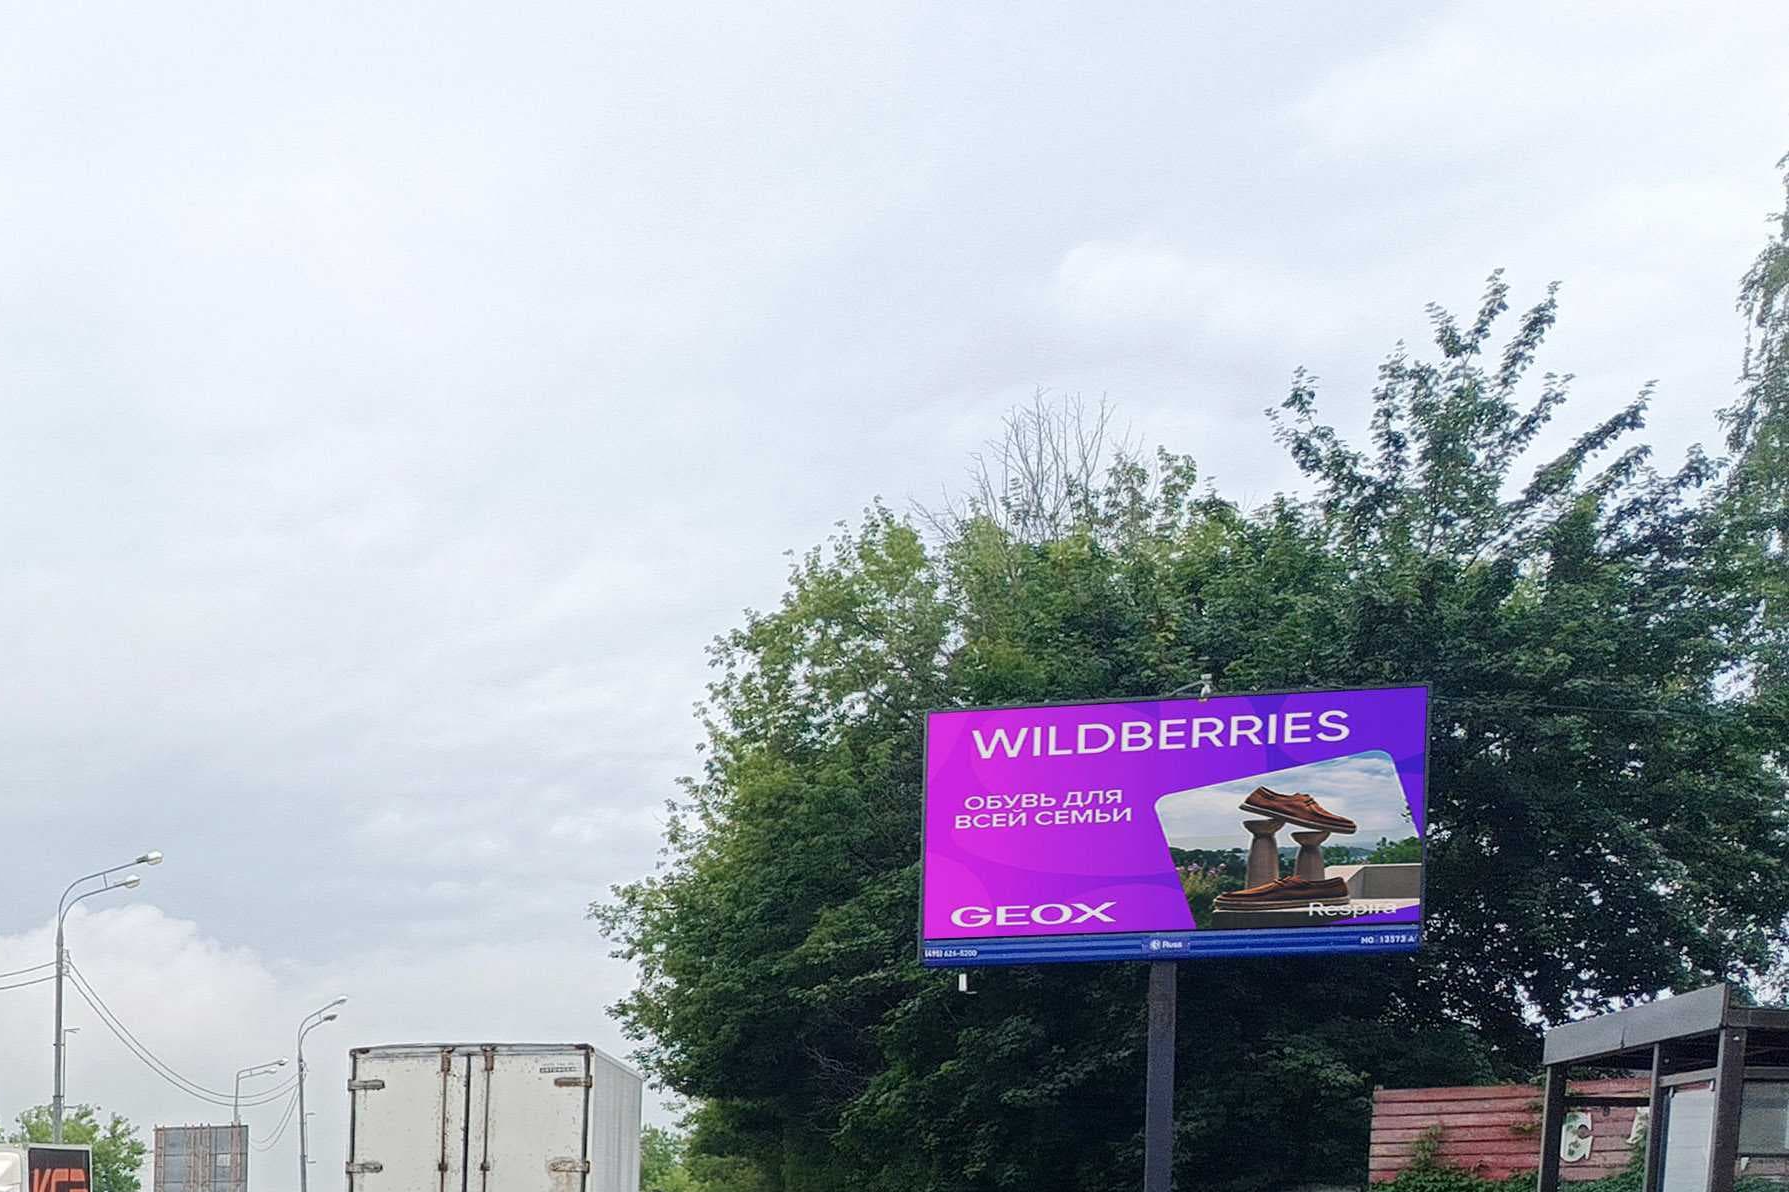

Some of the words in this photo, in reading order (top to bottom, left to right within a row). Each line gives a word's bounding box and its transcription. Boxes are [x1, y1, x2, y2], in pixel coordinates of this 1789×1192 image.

[972, 709, 1351, 760] WILDBERRIES
[964, 792, 1057, 811] ОБУВЬ
[1062, 789, 1123, 808] ДЛЯ
[954, 808, 1027, 829] ВСЕЙ
[1034, 807, 1132, 826] СЕМЬИ
[950, 901, 1117, 928] GEOX
[1308, 902, 1398, 919] Respira
